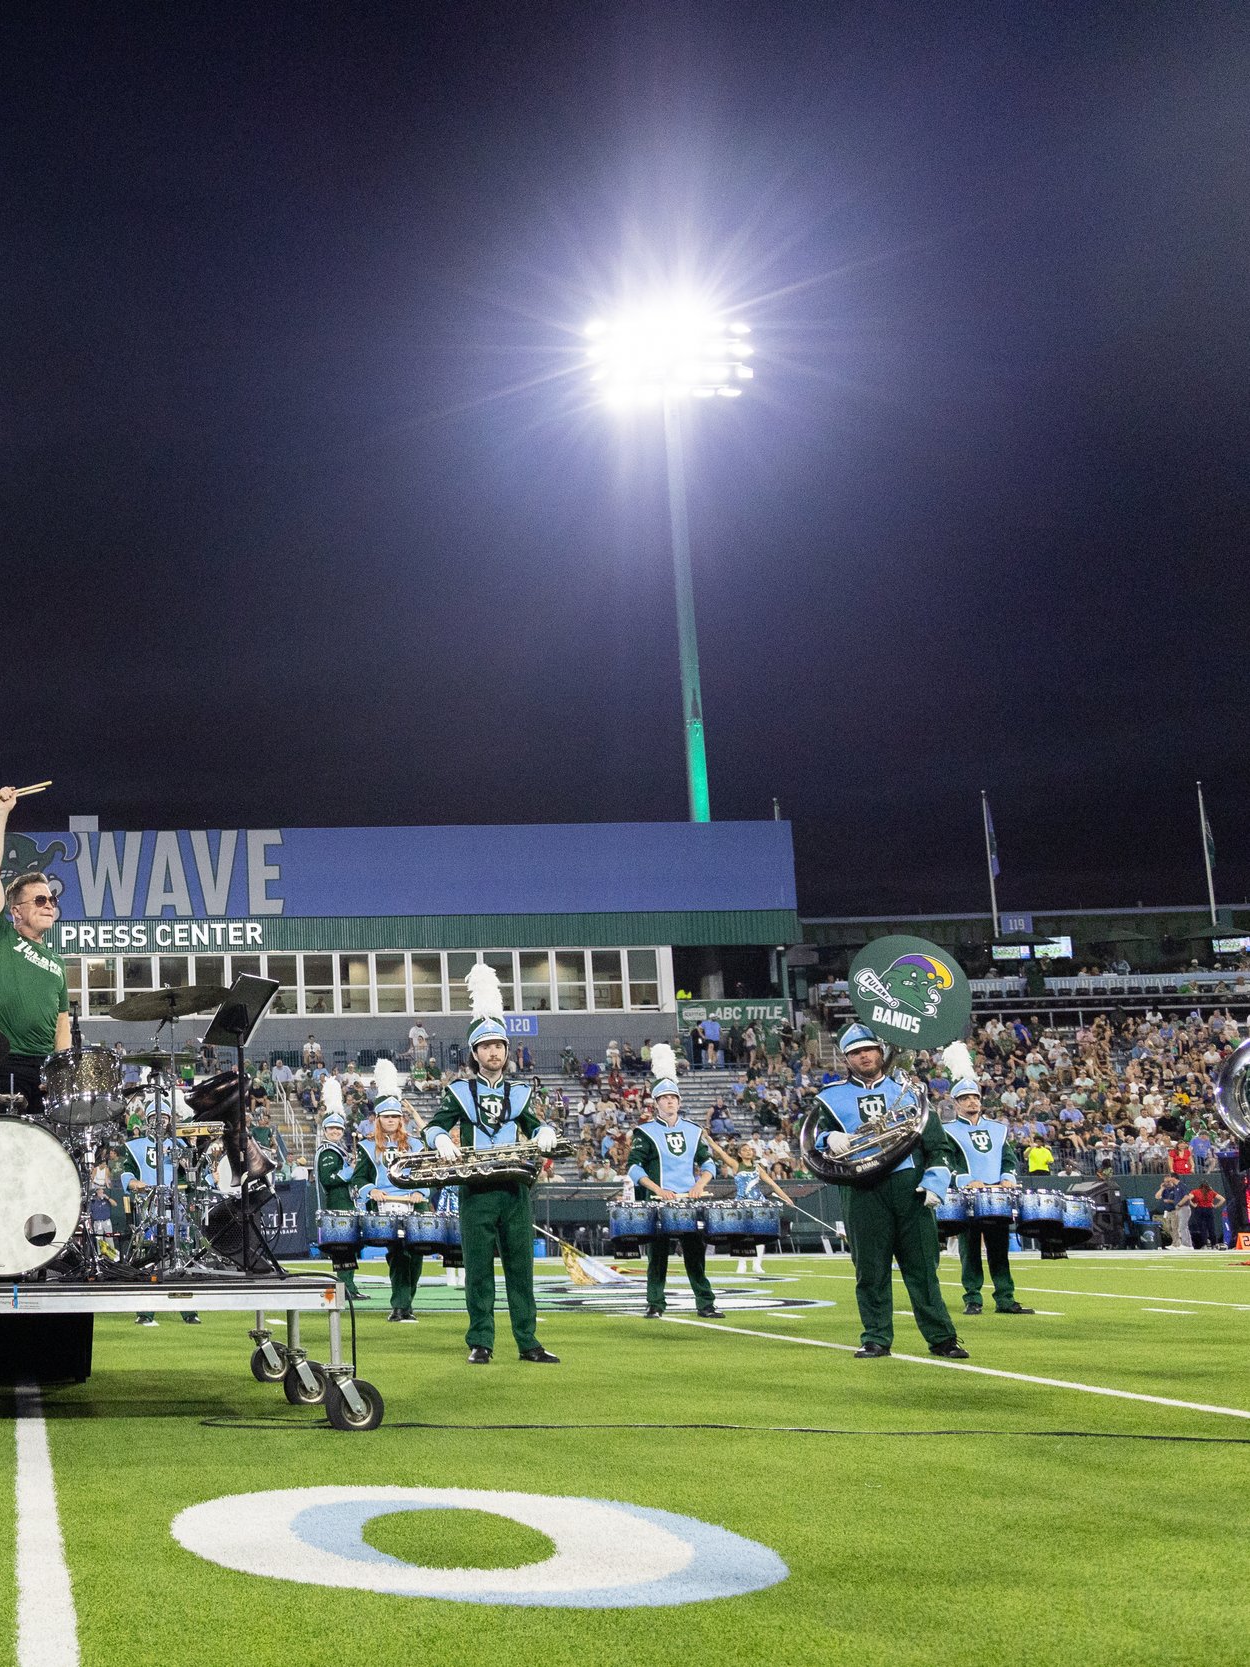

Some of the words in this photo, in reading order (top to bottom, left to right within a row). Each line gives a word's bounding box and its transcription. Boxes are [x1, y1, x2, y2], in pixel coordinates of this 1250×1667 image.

[76, 828, 285, 917] WAVE
[61, 925, 147, 948] PRESS
[155, 922, 264, 947] CENTER
[1008, 919, 1025, 931] 119
[714, 1006, 742, 1020] ABC
[745, 1005, 783, 1020] TITLE
[871, 1005, 921, 1034] BANDS
[509, 1018, 531, 1032] 120
